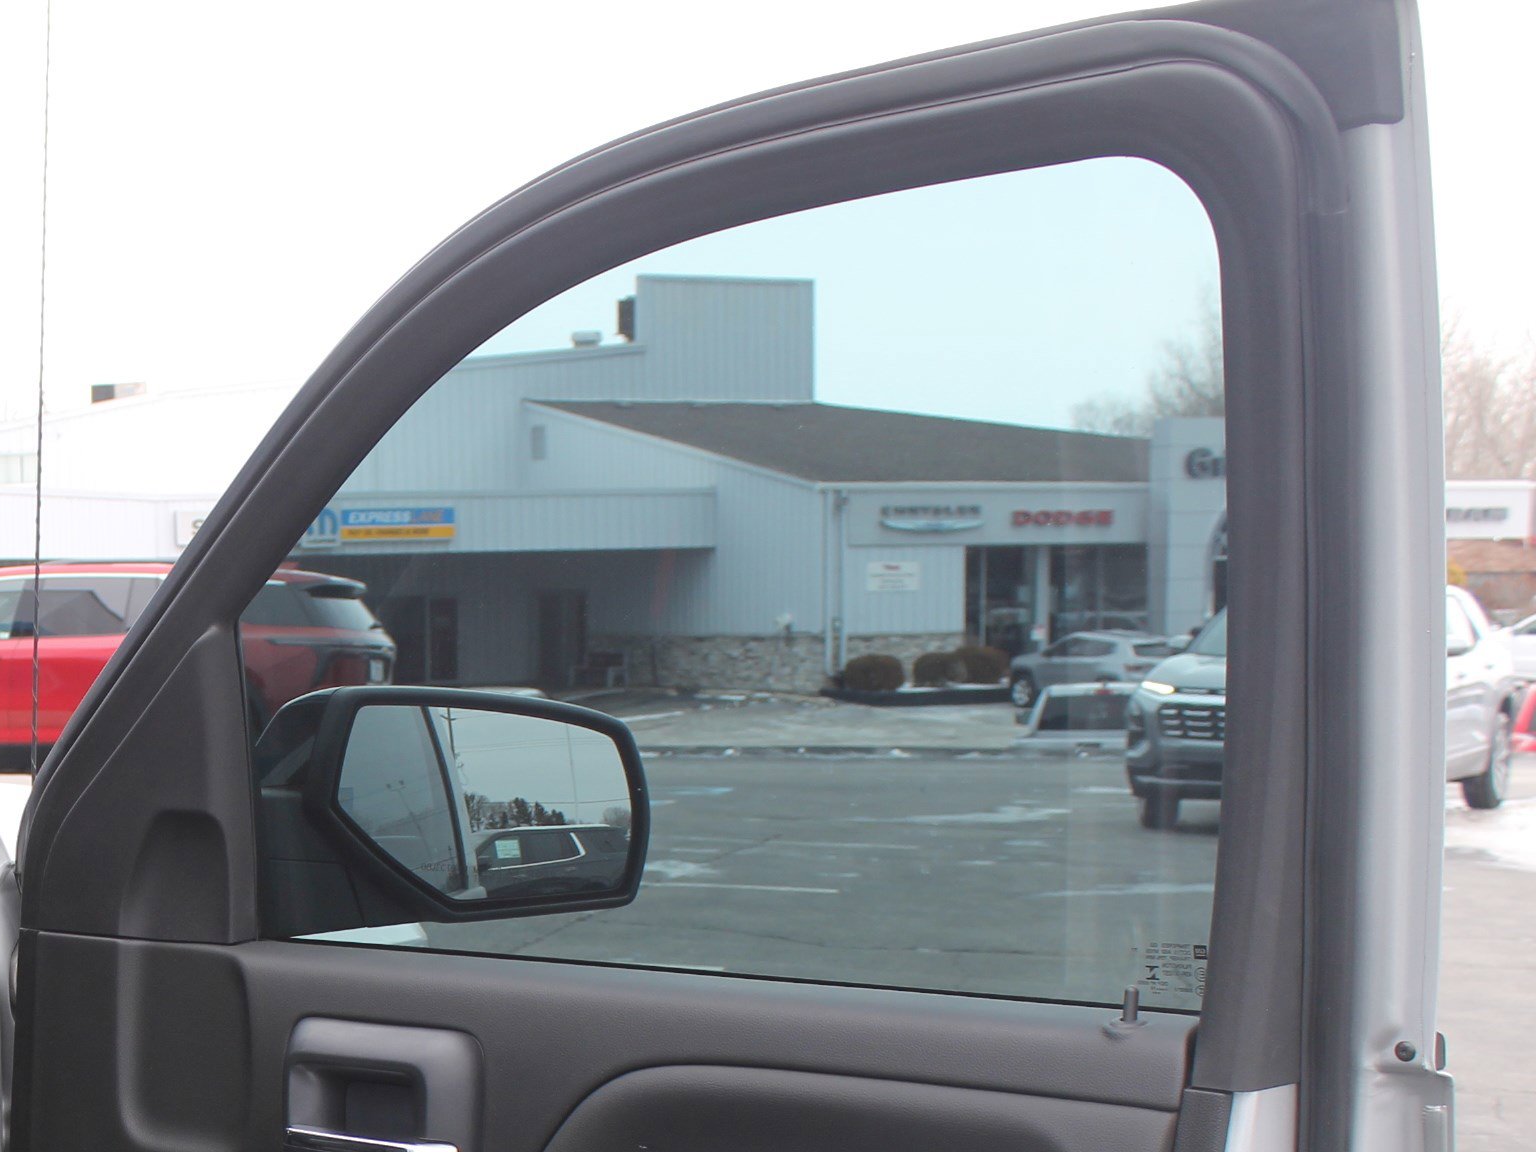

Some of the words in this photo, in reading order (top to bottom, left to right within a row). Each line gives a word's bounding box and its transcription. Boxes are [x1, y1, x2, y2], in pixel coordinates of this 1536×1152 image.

[348, 509, 413, 525] EXPRESS
[880, 505, 983, 518] CHRYSLER
[1011, 509, 1115, 527] DODGE
